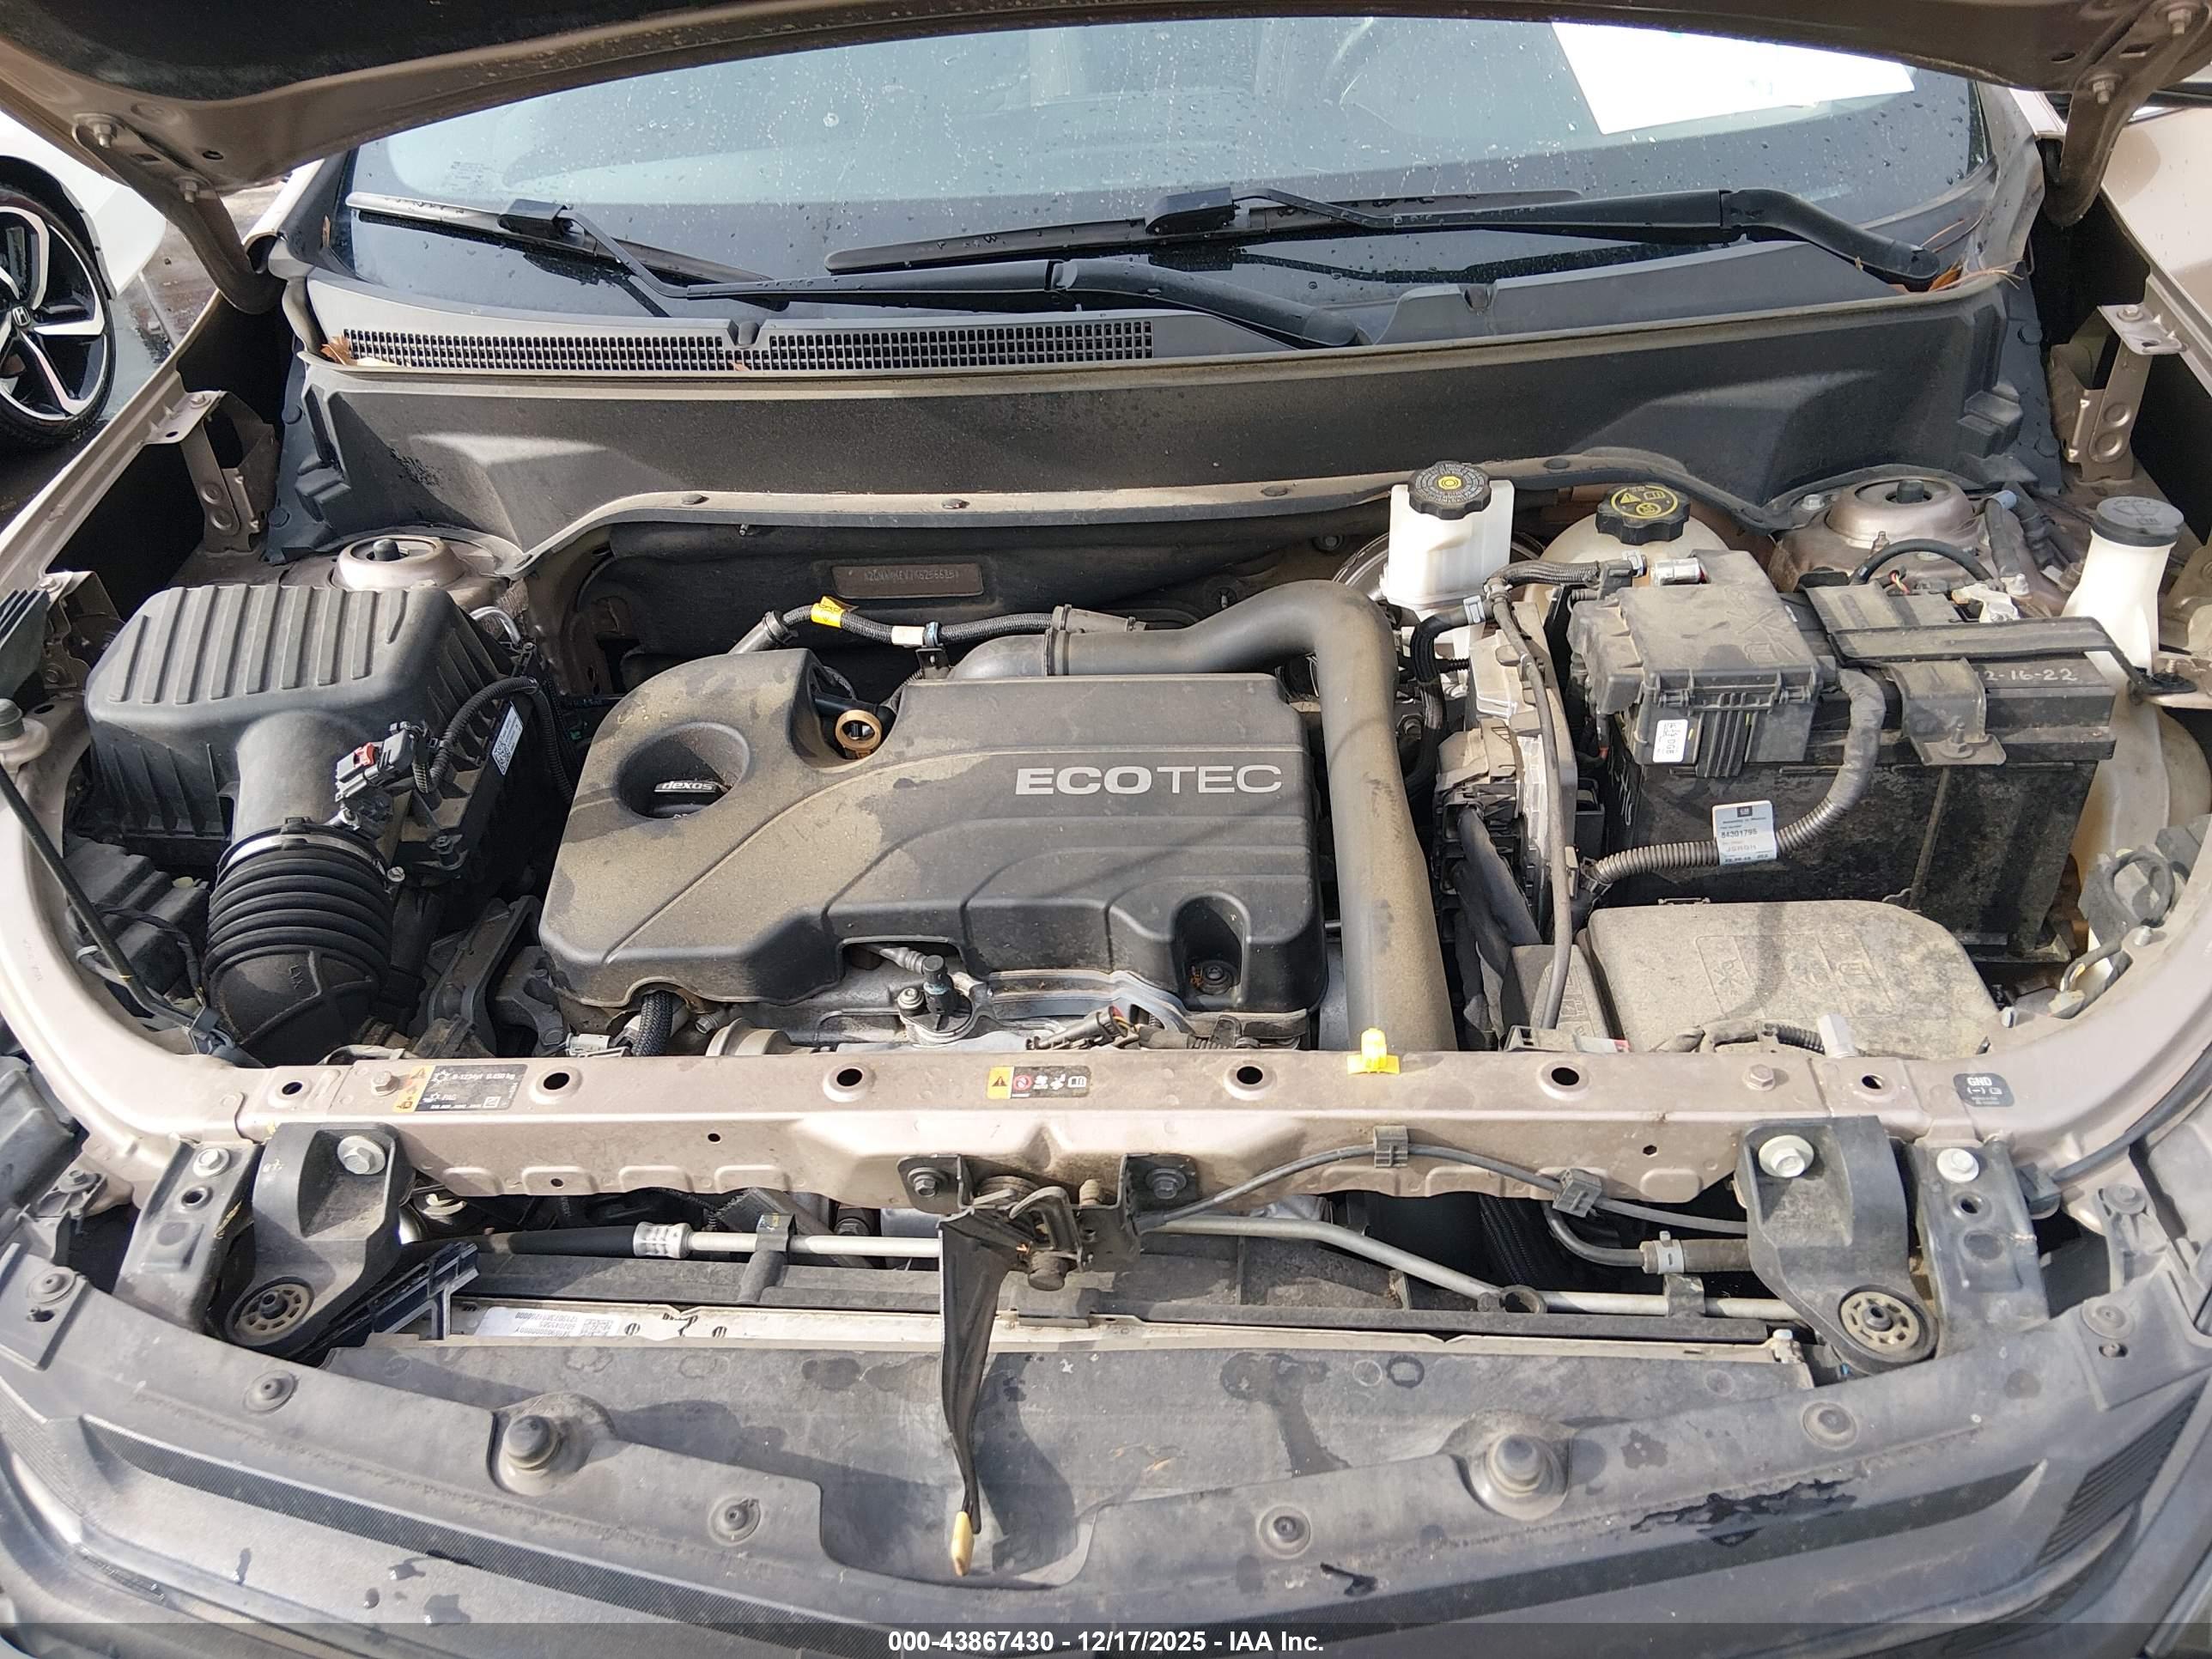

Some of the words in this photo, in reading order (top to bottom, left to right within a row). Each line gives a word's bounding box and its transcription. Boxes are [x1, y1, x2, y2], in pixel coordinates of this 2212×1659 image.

[1015, 764, 1283, 795] ECOTEC
[661, 781, 714, 791] dexos
[1966, 1076, 1993, 1086] GND
